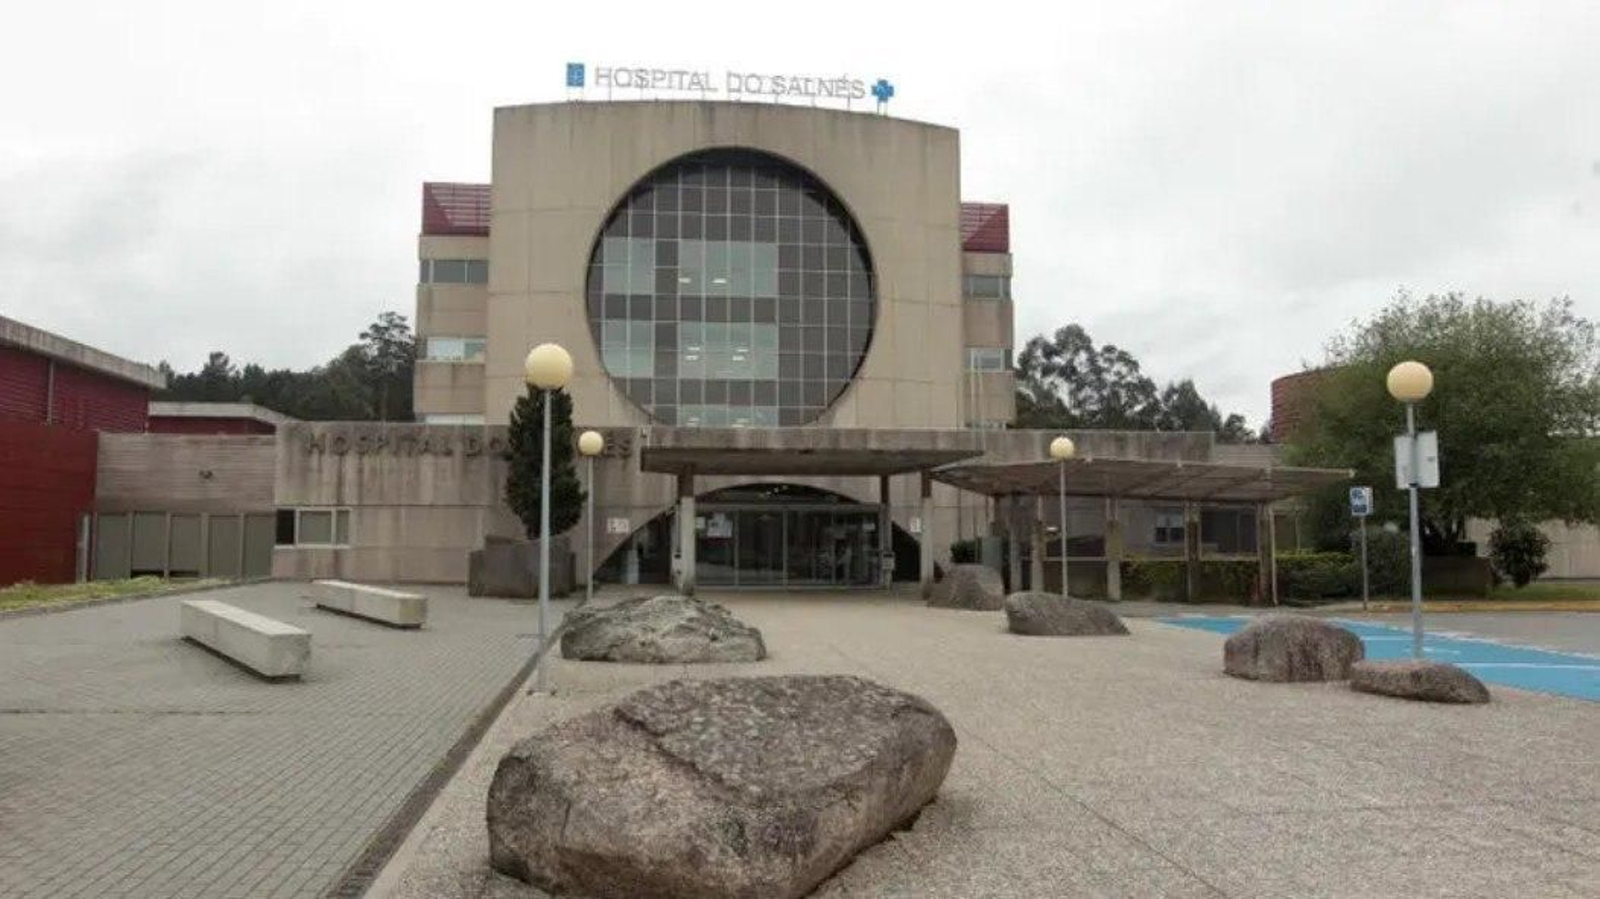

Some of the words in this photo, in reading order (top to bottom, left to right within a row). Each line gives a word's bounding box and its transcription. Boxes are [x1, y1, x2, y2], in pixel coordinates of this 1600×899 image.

[595, 66, 718, 92] HOSPITAL
[727, 71, 763, 94] DO
[307, 432, 453, 457] HOSPITAL
